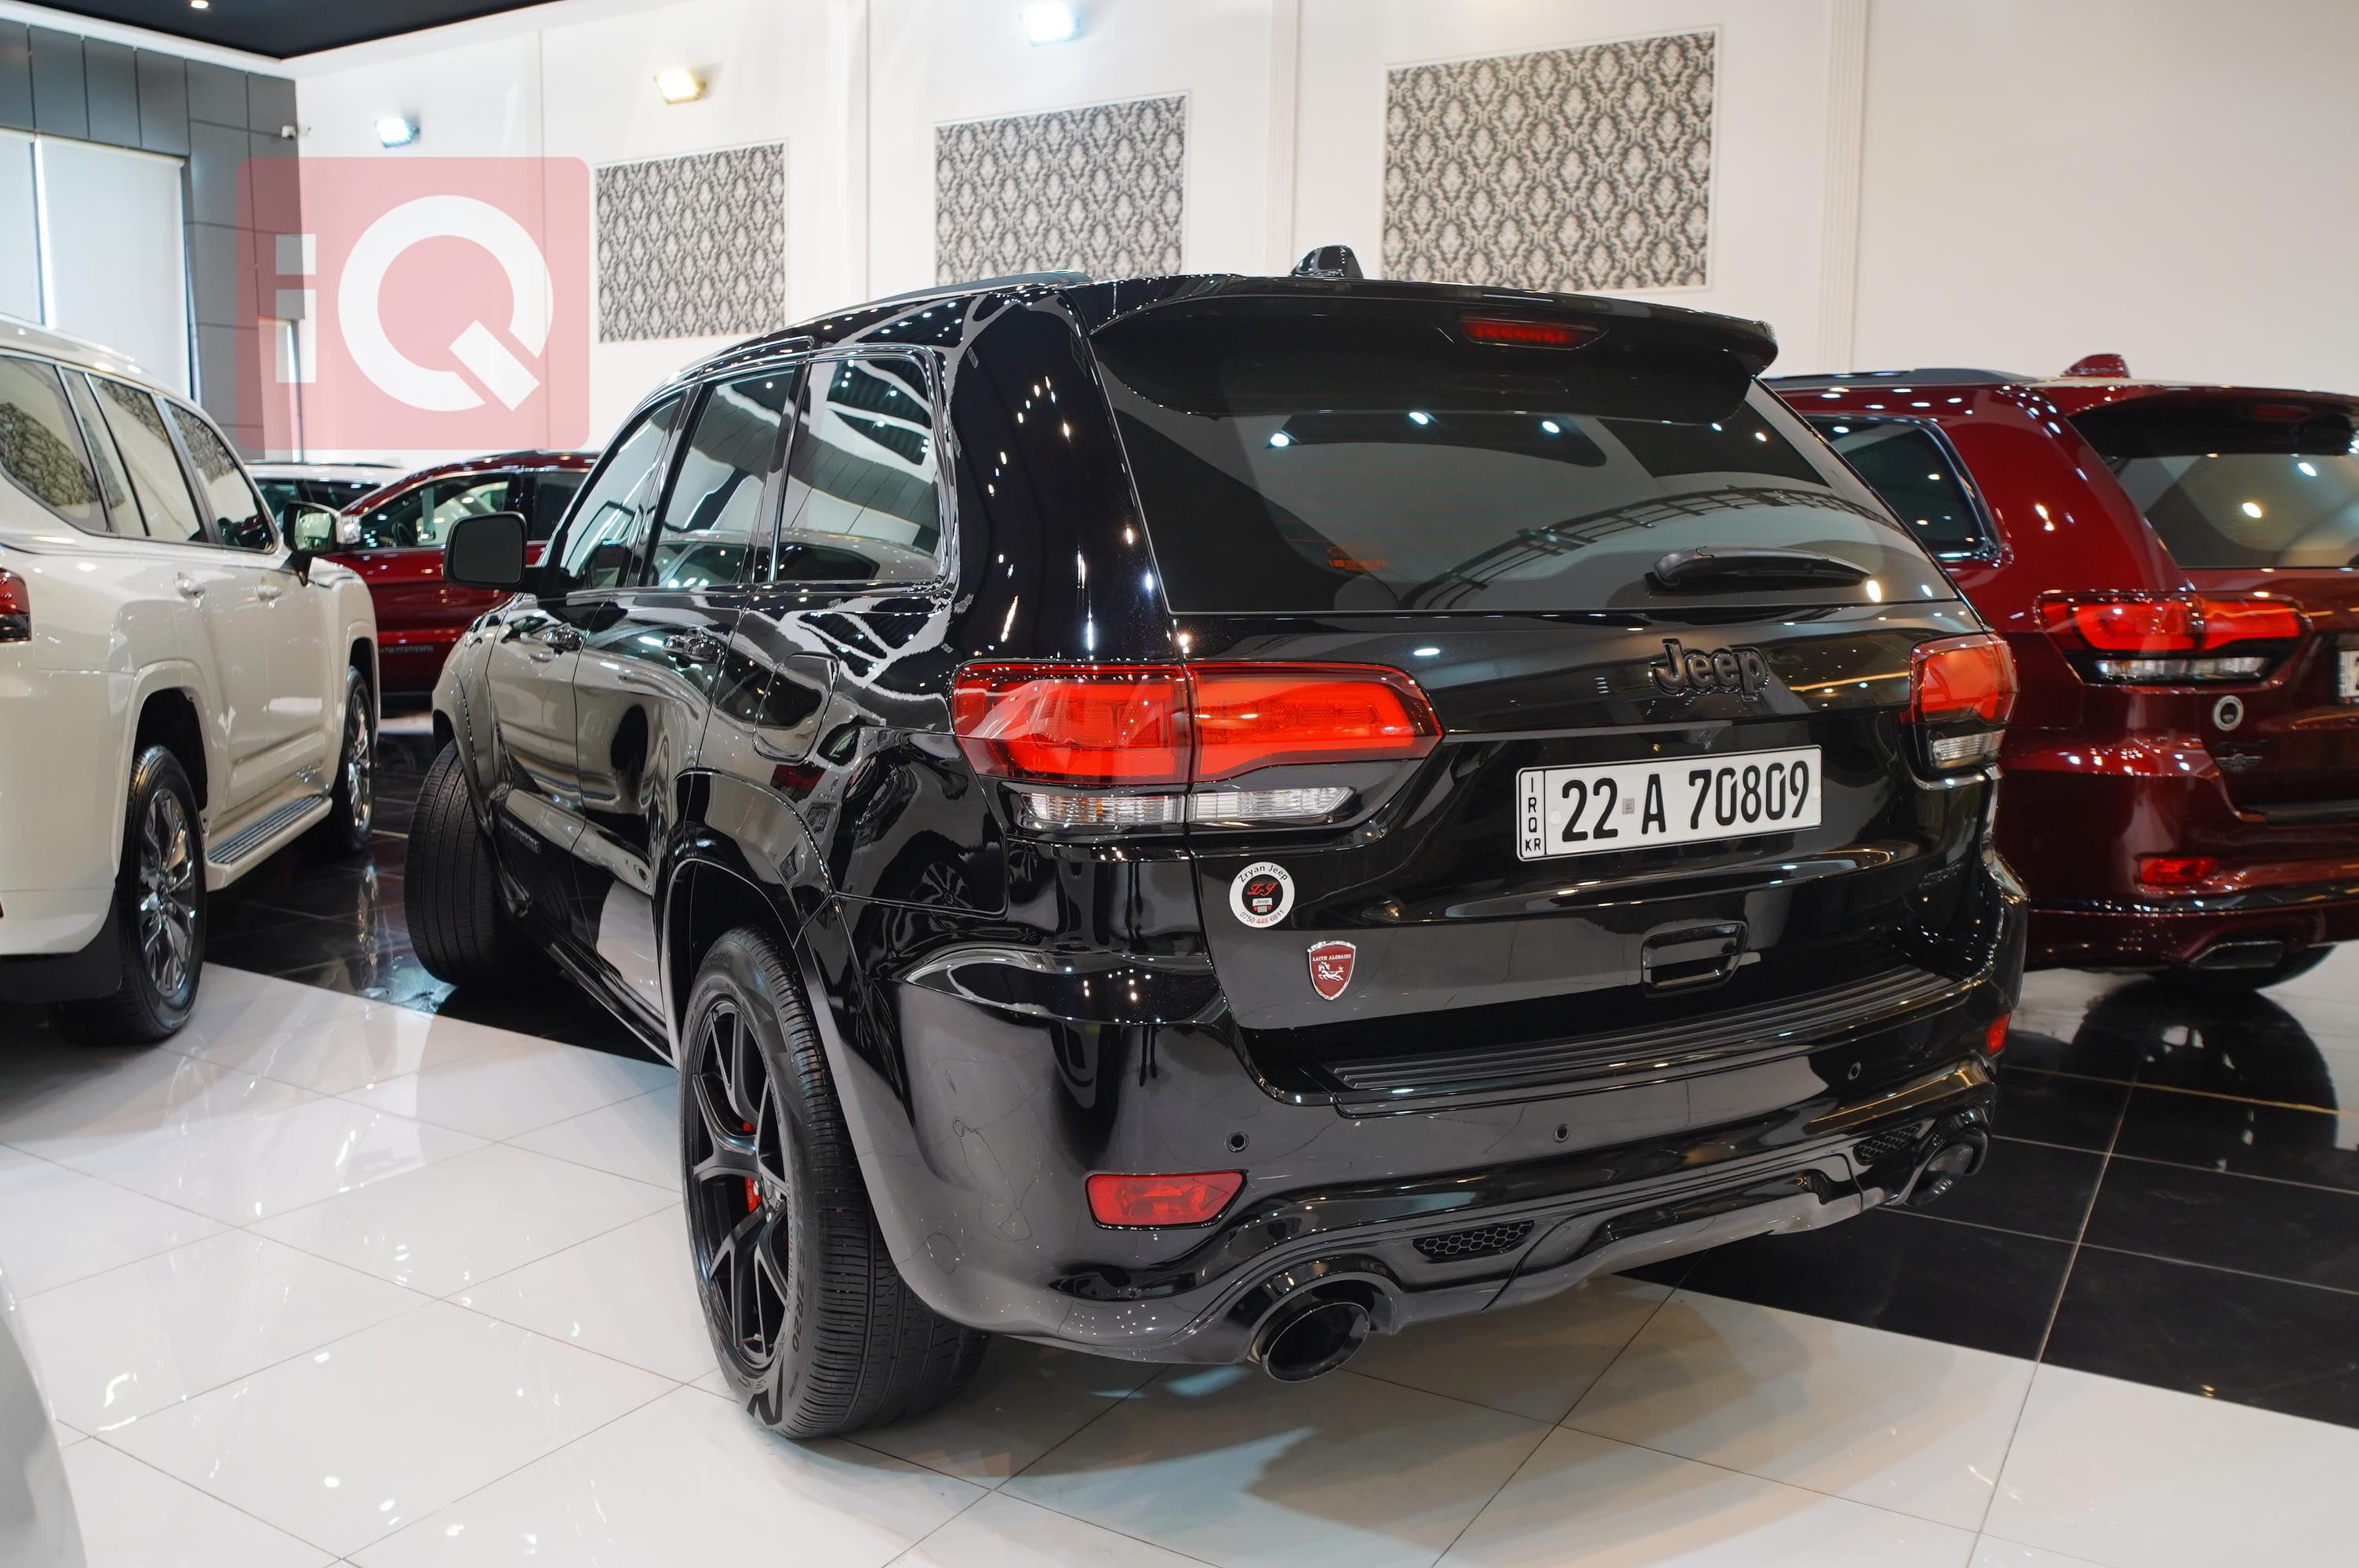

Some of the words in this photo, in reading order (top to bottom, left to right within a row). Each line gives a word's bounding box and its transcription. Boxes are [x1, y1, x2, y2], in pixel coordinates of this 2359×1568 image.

[1649, 638, 1769, 702] Jeep
[1561, 776, 1619, 843] 22
[1641, 773, 1667, 835] A
[1689, 760, 1809, 830] 70809
[1525, 837, 1541, 852] KR
[1238, 865, 1266, 883] Zryan
[1268, 865, 1288, 881] Jeep
[1240, 911, 1256, 924] 0750
[1270, 909, 1284, 922] 6811
